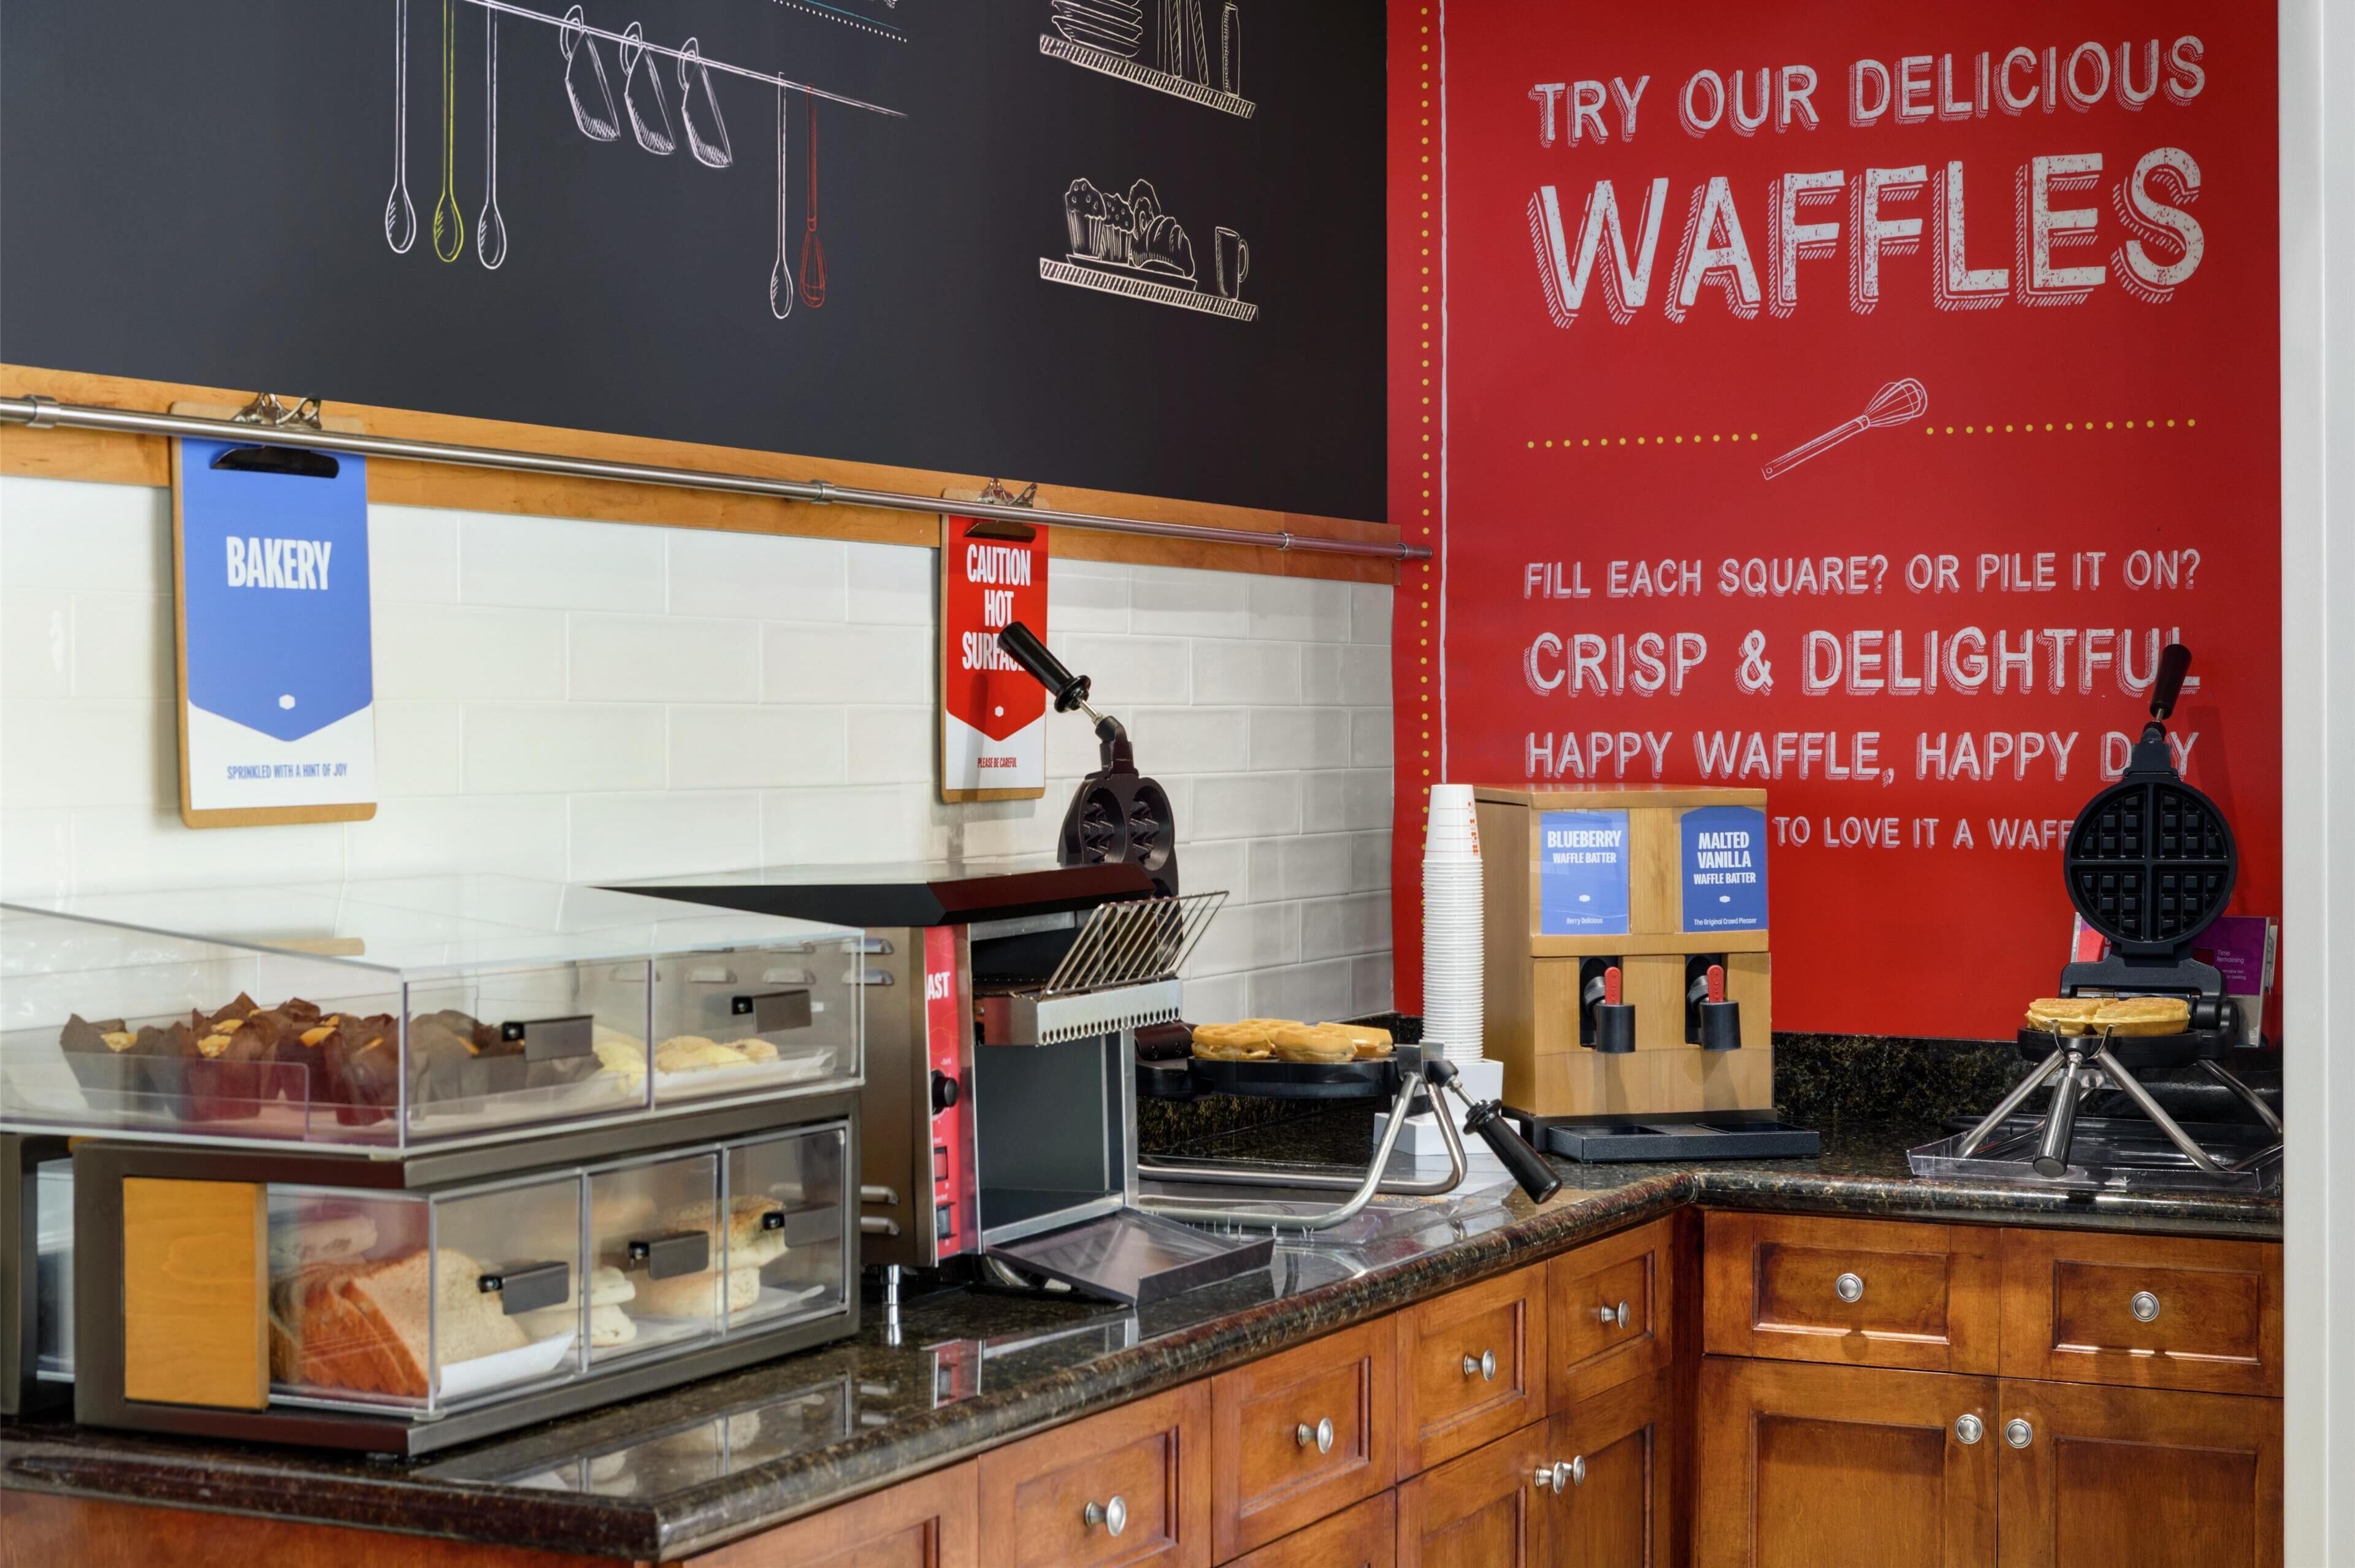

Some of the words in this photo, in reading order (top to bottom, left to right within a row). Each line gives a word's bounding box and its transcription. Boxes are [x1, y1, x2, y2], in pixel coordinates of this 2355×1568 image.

[1527, 75, 1650, 148] TRY
[1678, 64, 1820, 138] OUR
[1848, 35, 2205, 128] DELICIOUS
[1526, 146, 2204, 329] WAFFLES
[226, 537, 332, 591] BAKERY
[967, 544, 1031, 586] CAUTION
[1524, 561, 1591, 599] FILL
[1607, 559, 1702, 598] EACH
[1717, 554, 1889, 599] SQUARE?
[1905, 553, 1960, 594] OR
[1977, 552, 2056, 592] PILE
[2072, 552, 2107, 591] IT
[2123, 548, 2201, 591] ON?
[985, 589, 1014, 628] HOT
[962, 631, 1025, 672] SURFA
[1523, 632, 1707, 698] CRISP
[1735, 629, 1774, 697] &
[228, 765, 271, 780] SPRINKLED
[274, 765, 294, 778] WITH
[296, 765, 301, 778] A
[303, 763, 320, 777] HINT
[323, 763, 331, 777] OF
[334, 763, 348, 777] JOY
[978, 757, 992, 768] PLEASE
[994, 757, 998, 768] BE
[1000, 757, 1017, 768] CAREFUL
[1525, 731, 1673, 779] HAPPY
[1692, 730, 1894, 789] WAFFLE,
[1916, 731, 2079, 782] HAPPY
[2100, 732, 2199, 782] DY
[1547, 830, 1622, 848] BLUEBERRY
[1698, 832, 1750, 849] MALTED
[1772, 816, 1810, 847] TO
[1824, 816, 1901, 848] LOVE
[1913, 817, 1939, 848] IT
[1953, 818, 1974, 849] A
[1988, 818, 2075, 851] WAFF
[1553, 852, 1584, 863] WAFFLE
[1585, 852, 1617, 863] BATTER
[1697, 851, 1752, 869] VANILLA
[1693, 873, 1725, 885] WAFFLE
[1725, 872, 1756, 884] BATTER
[927, 971, 951, 1001] AST
